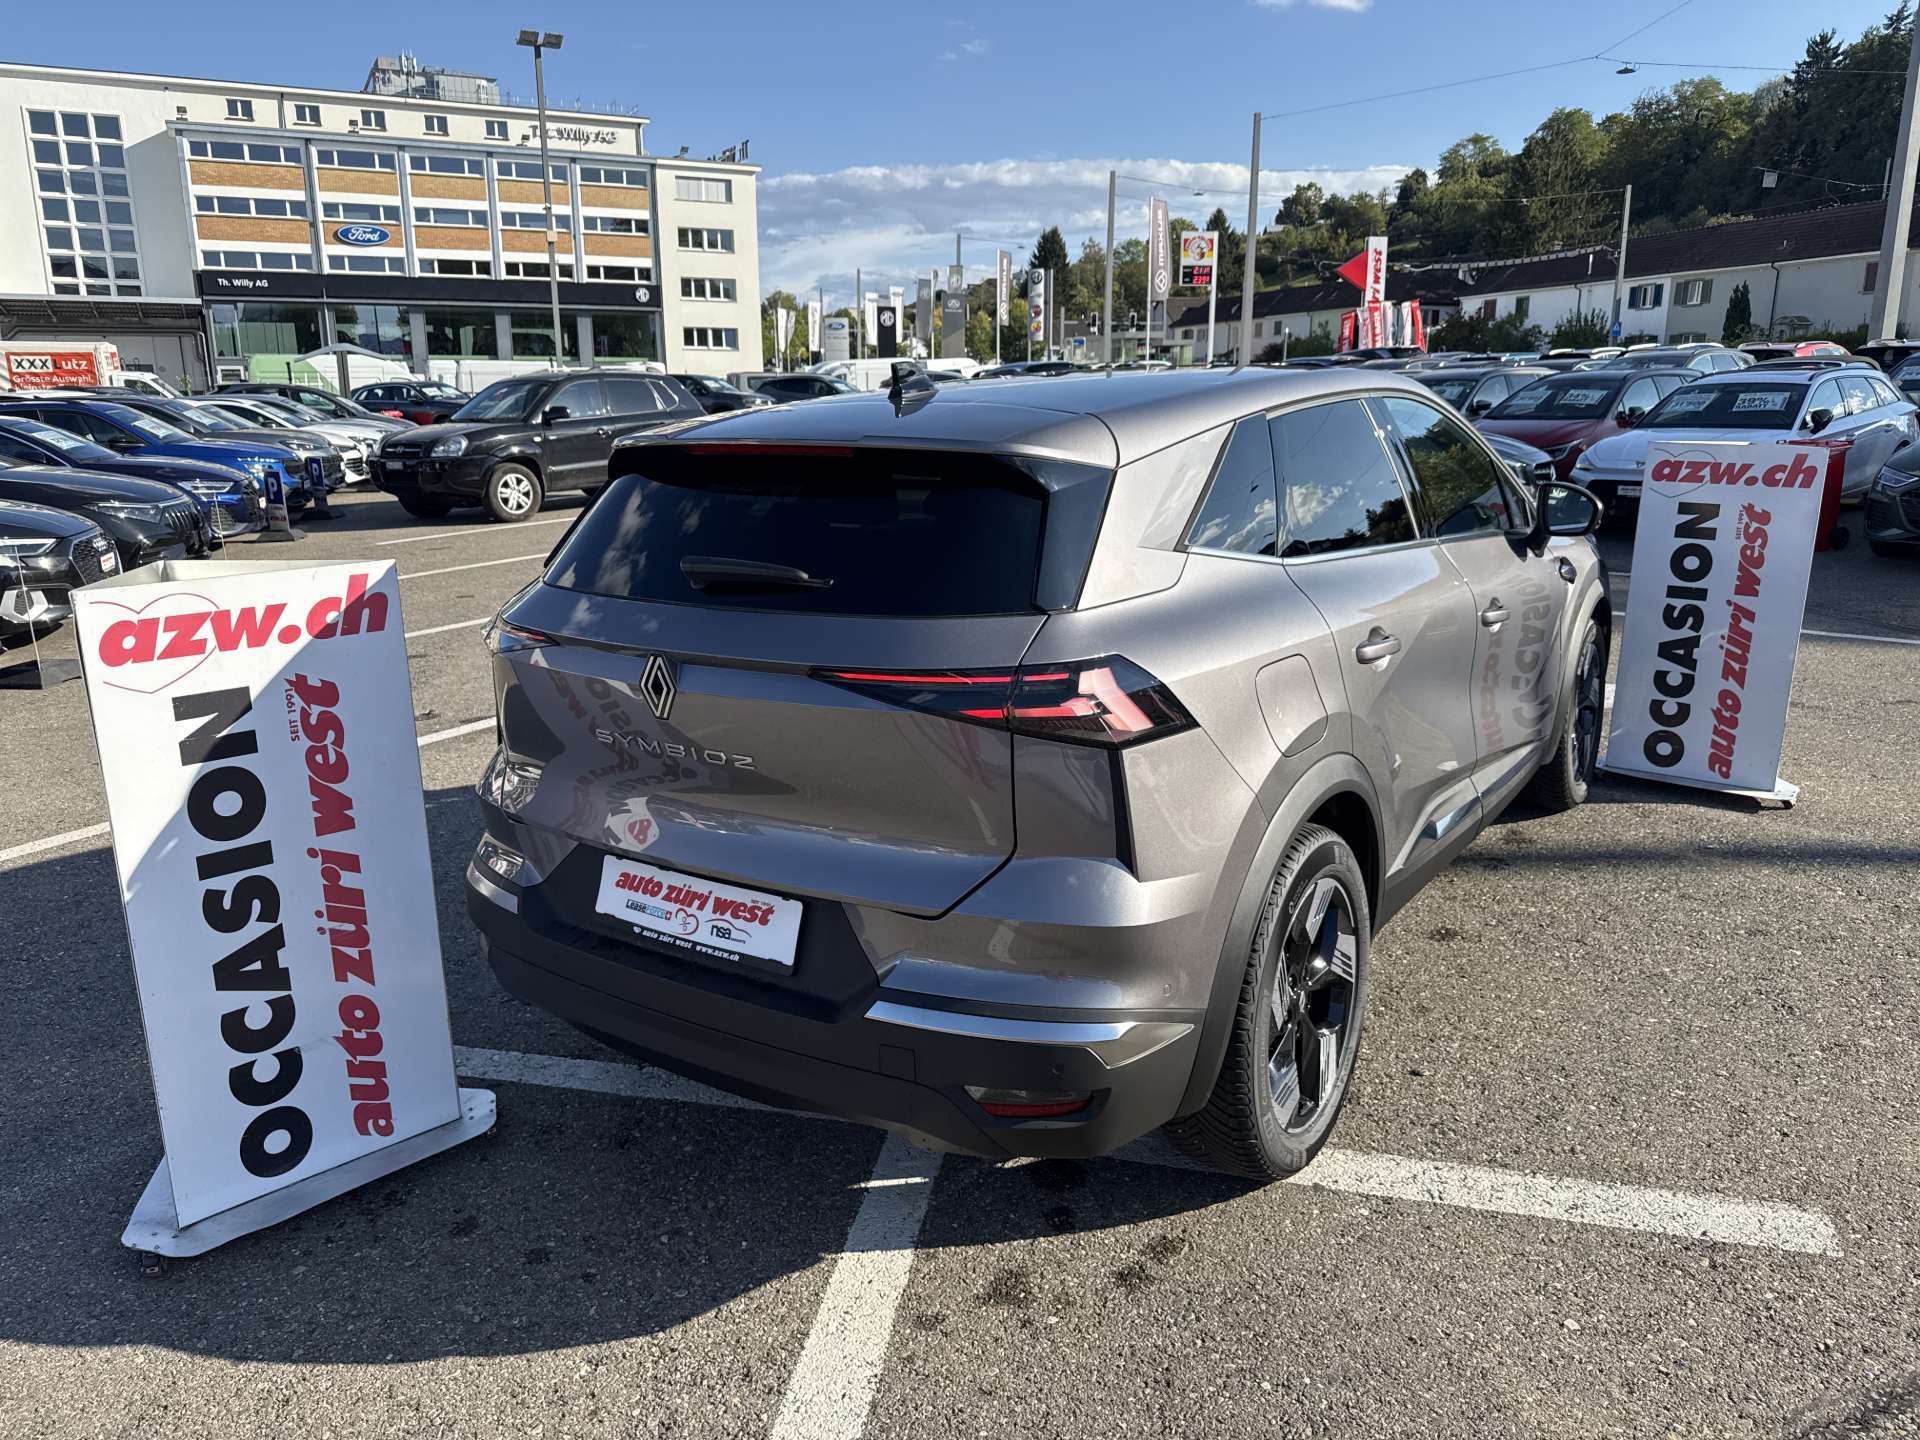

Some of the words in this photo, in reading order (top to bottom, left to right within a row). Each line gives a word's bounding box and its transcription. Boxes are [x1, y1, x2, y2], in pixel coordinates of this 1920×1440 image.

[348, 226, 381, 241] Ford
[217, 277, 231, 287] Th.
[232, 278, 254, 289] Willy
[255, 279, 269, 288] AG
[1373, 247, 1382, 284] west
[13, 375, 51, 383] Grösste
[268, 477, 278, 500] P
[1651, 453, 1818, 489] azw.ch
[1733, 502, 1772, 598] west
[98, 573, 389, 668] azw.ch
[1643, 501, 1721, 768] OCCASION
[1718, 599, 1757, 691] züri
[285, 687, 296, 714] 1991
[289, 718, 300, 742] SEIT
[594, 729, 757, 770] SYMBIOZ
[1708, 688, 1742, 780] auto
[283, 672, 356, 837] west
[306, 847, 376, 986] züri
[615, 871, 664, 898] auto
[661, 883, 713, 912] züri
[712, 896, 775, 926] west
[171, 685, 313, 1178] OCCASION
[642, 929, 658, 939] auto
[675, 939, 692, 949] west
[711, 924, 732, 941] nsa
[332, 994, 395, 1137] auto
